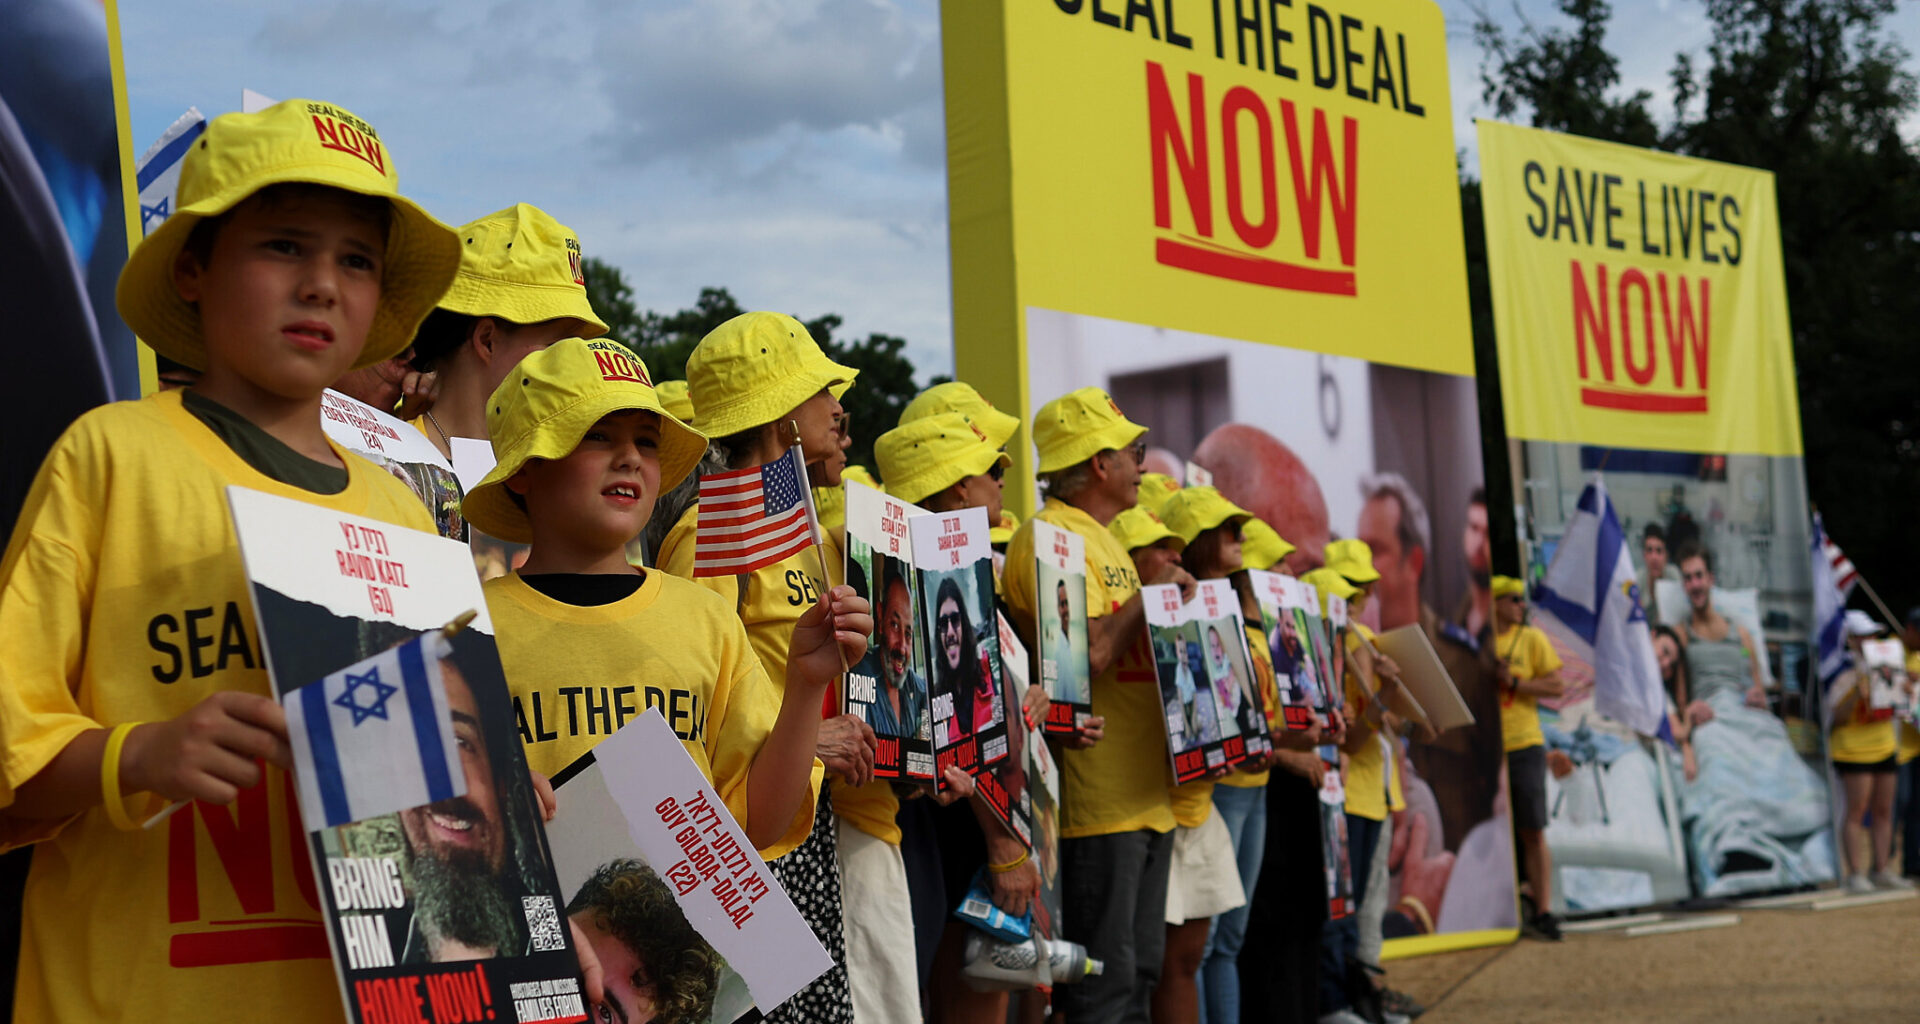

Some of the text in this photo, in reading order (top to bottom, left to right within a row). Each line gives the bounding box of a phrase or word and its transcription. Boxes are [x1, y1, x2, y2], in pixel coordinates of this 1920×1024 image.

[1308, 4, 1426, 118] DEAL
[307, 103, 336, 117] SEAL
[312, 114, 386, 171] NOW
[1145, 59, 1359, 268] NOW
[1524, 160, 1742, 266] SAVE LIVES
[587, 341, 611, 350] SEAL
[1570, 258, 1710, 391] NOW
[594, 350, 654, 387] NOW
[320, 404, 348, 425] EDEN
[361, 429, 384, 453] (24)
[338, 520, 389, 556] רביד כץ
[335, 548, 409, 588] RAVID KATZ
[366, 583, 395, 617] (51)
[147, 601, 267, 685] SEA
[513, 690, 557, 744] AL
[558, 685, 636, 737] THE
[849, 672, 877, 704] BRING
[874, 737, 899, 768] NOW!
[655, 796, 754, 930] GUY GILBOA-DALAL
[684, 789, 770, 905] גיא גלבוע-דלאל
[326, 857, 405, 911] BRING
[665, 859, 702, 897] (22)
[339, 914, 395, 970] HIM
[354, 962, 496, 1024] HOME NOW!
